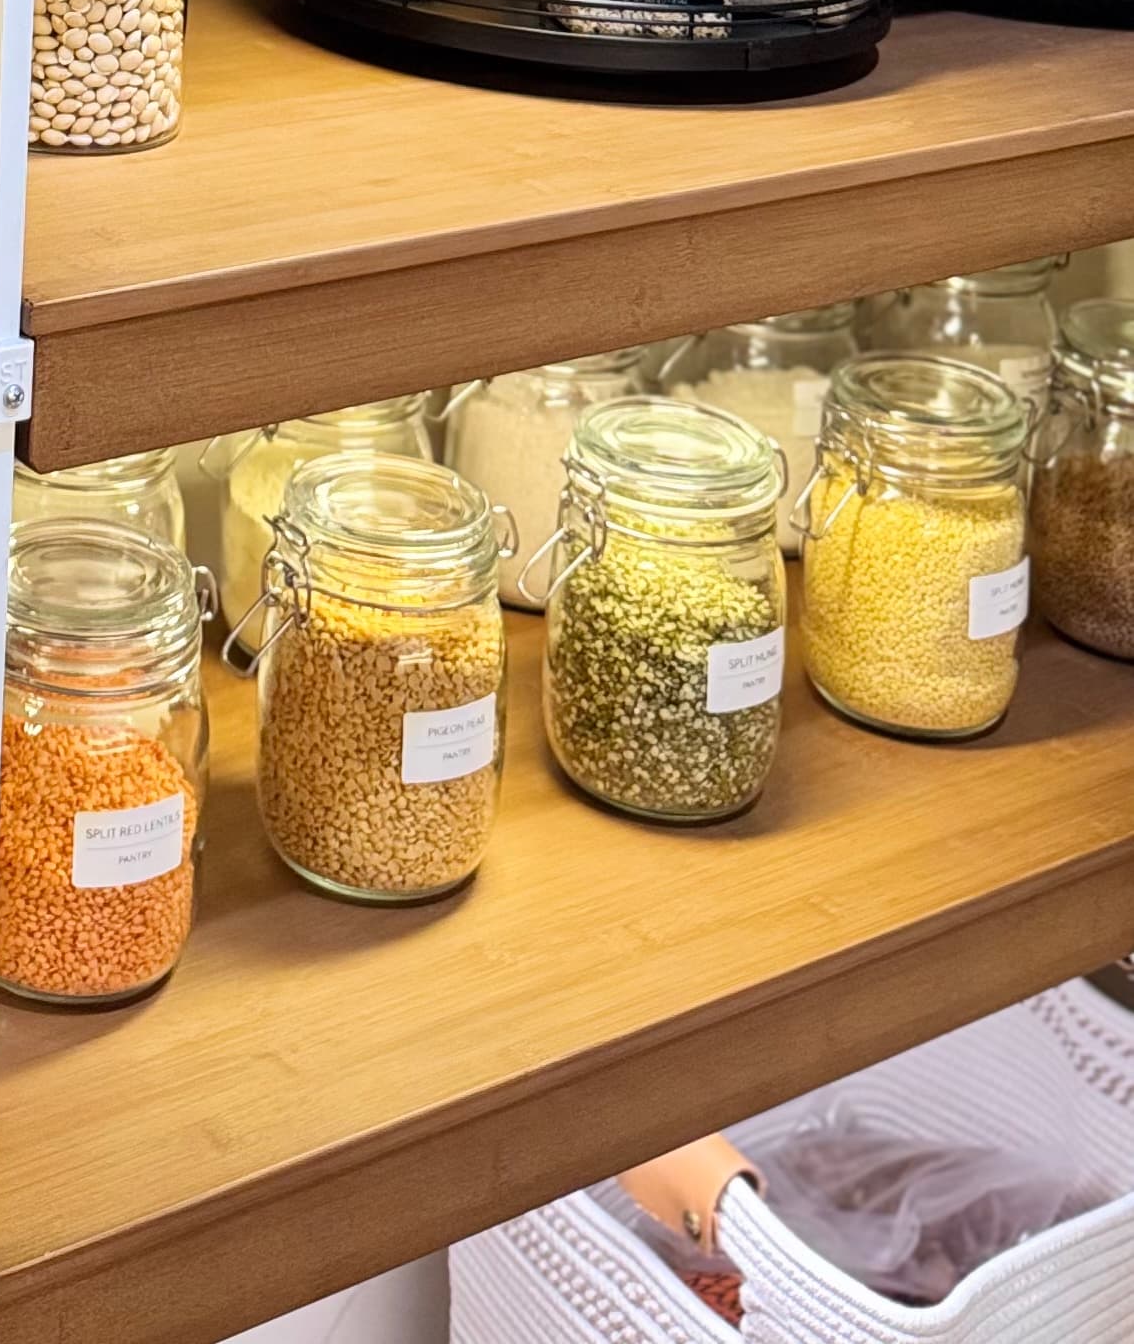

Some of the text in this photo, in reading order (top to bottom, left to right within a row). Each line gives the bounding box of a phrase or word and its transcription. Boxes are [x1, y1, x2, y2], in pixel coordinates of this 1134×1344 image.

[0, 359, 28, 385] ST
[86, 811, 180, 840] SPLIT RED LENTILS
